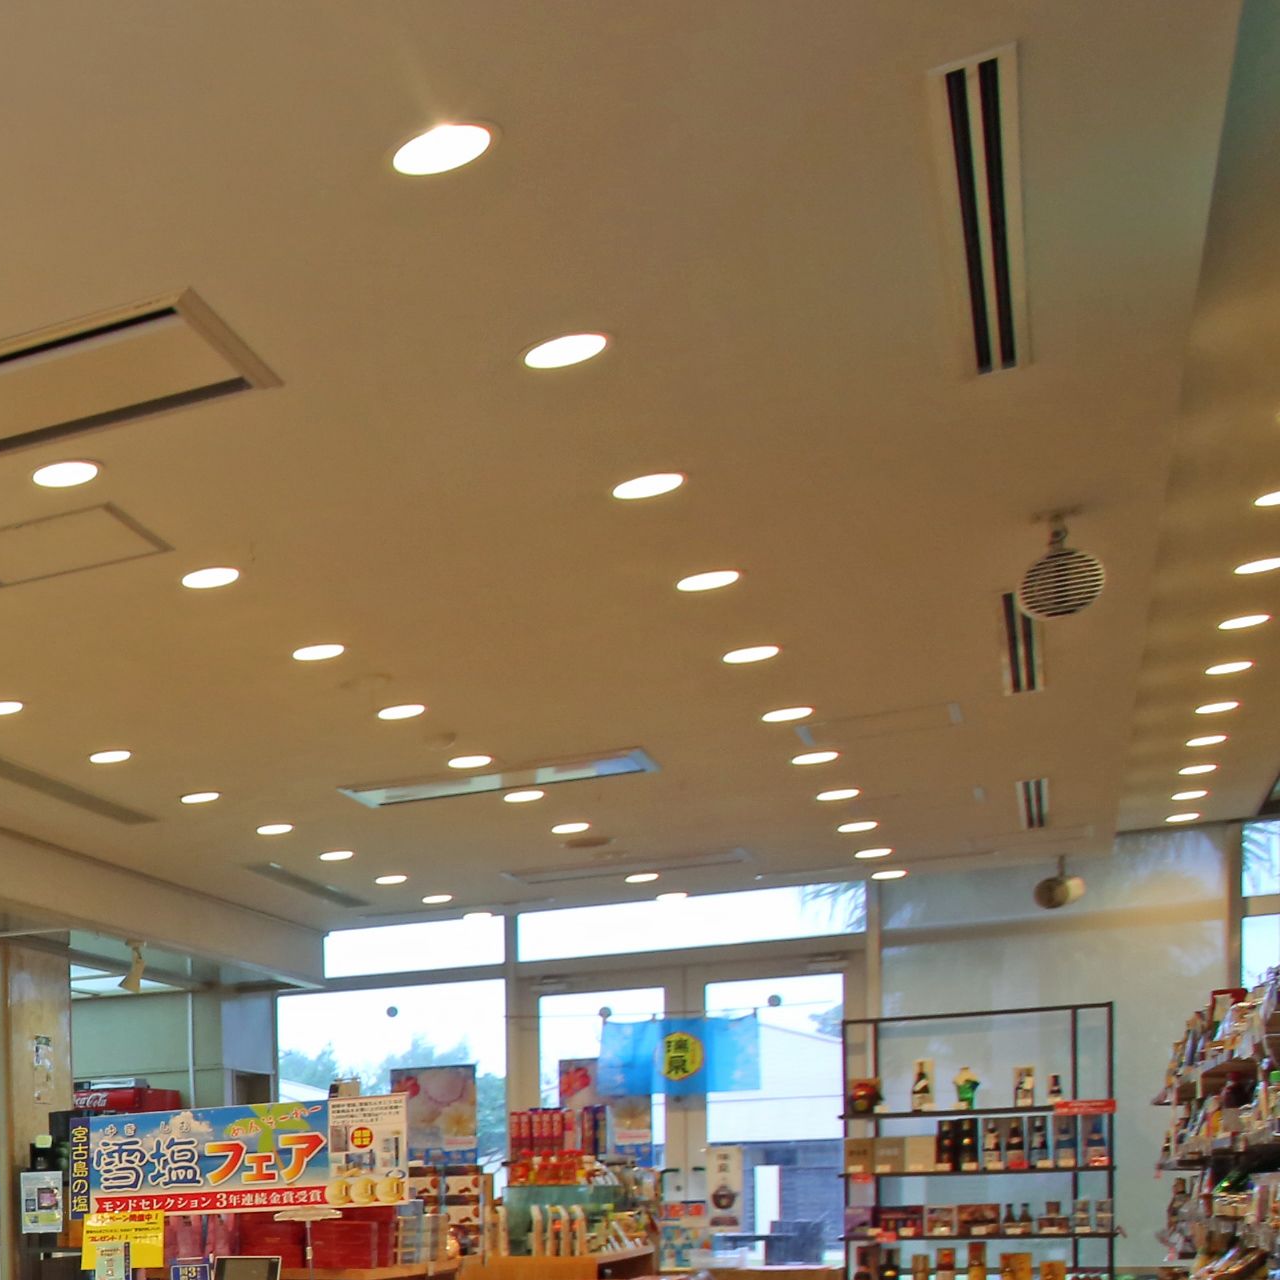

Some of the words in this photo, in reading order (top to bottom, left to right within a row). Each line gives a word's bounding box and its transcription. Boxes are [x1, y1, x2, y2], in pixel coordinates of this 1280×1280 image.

[71, 1125, 91, 1213] 宮古島の塩
[93, 1130, 327, 1194] 雪塩フェア
[101, 1195, 213, 1213] モンドセレクション
[216, 1187, 325, 1209] 3年連続金賞受賞
